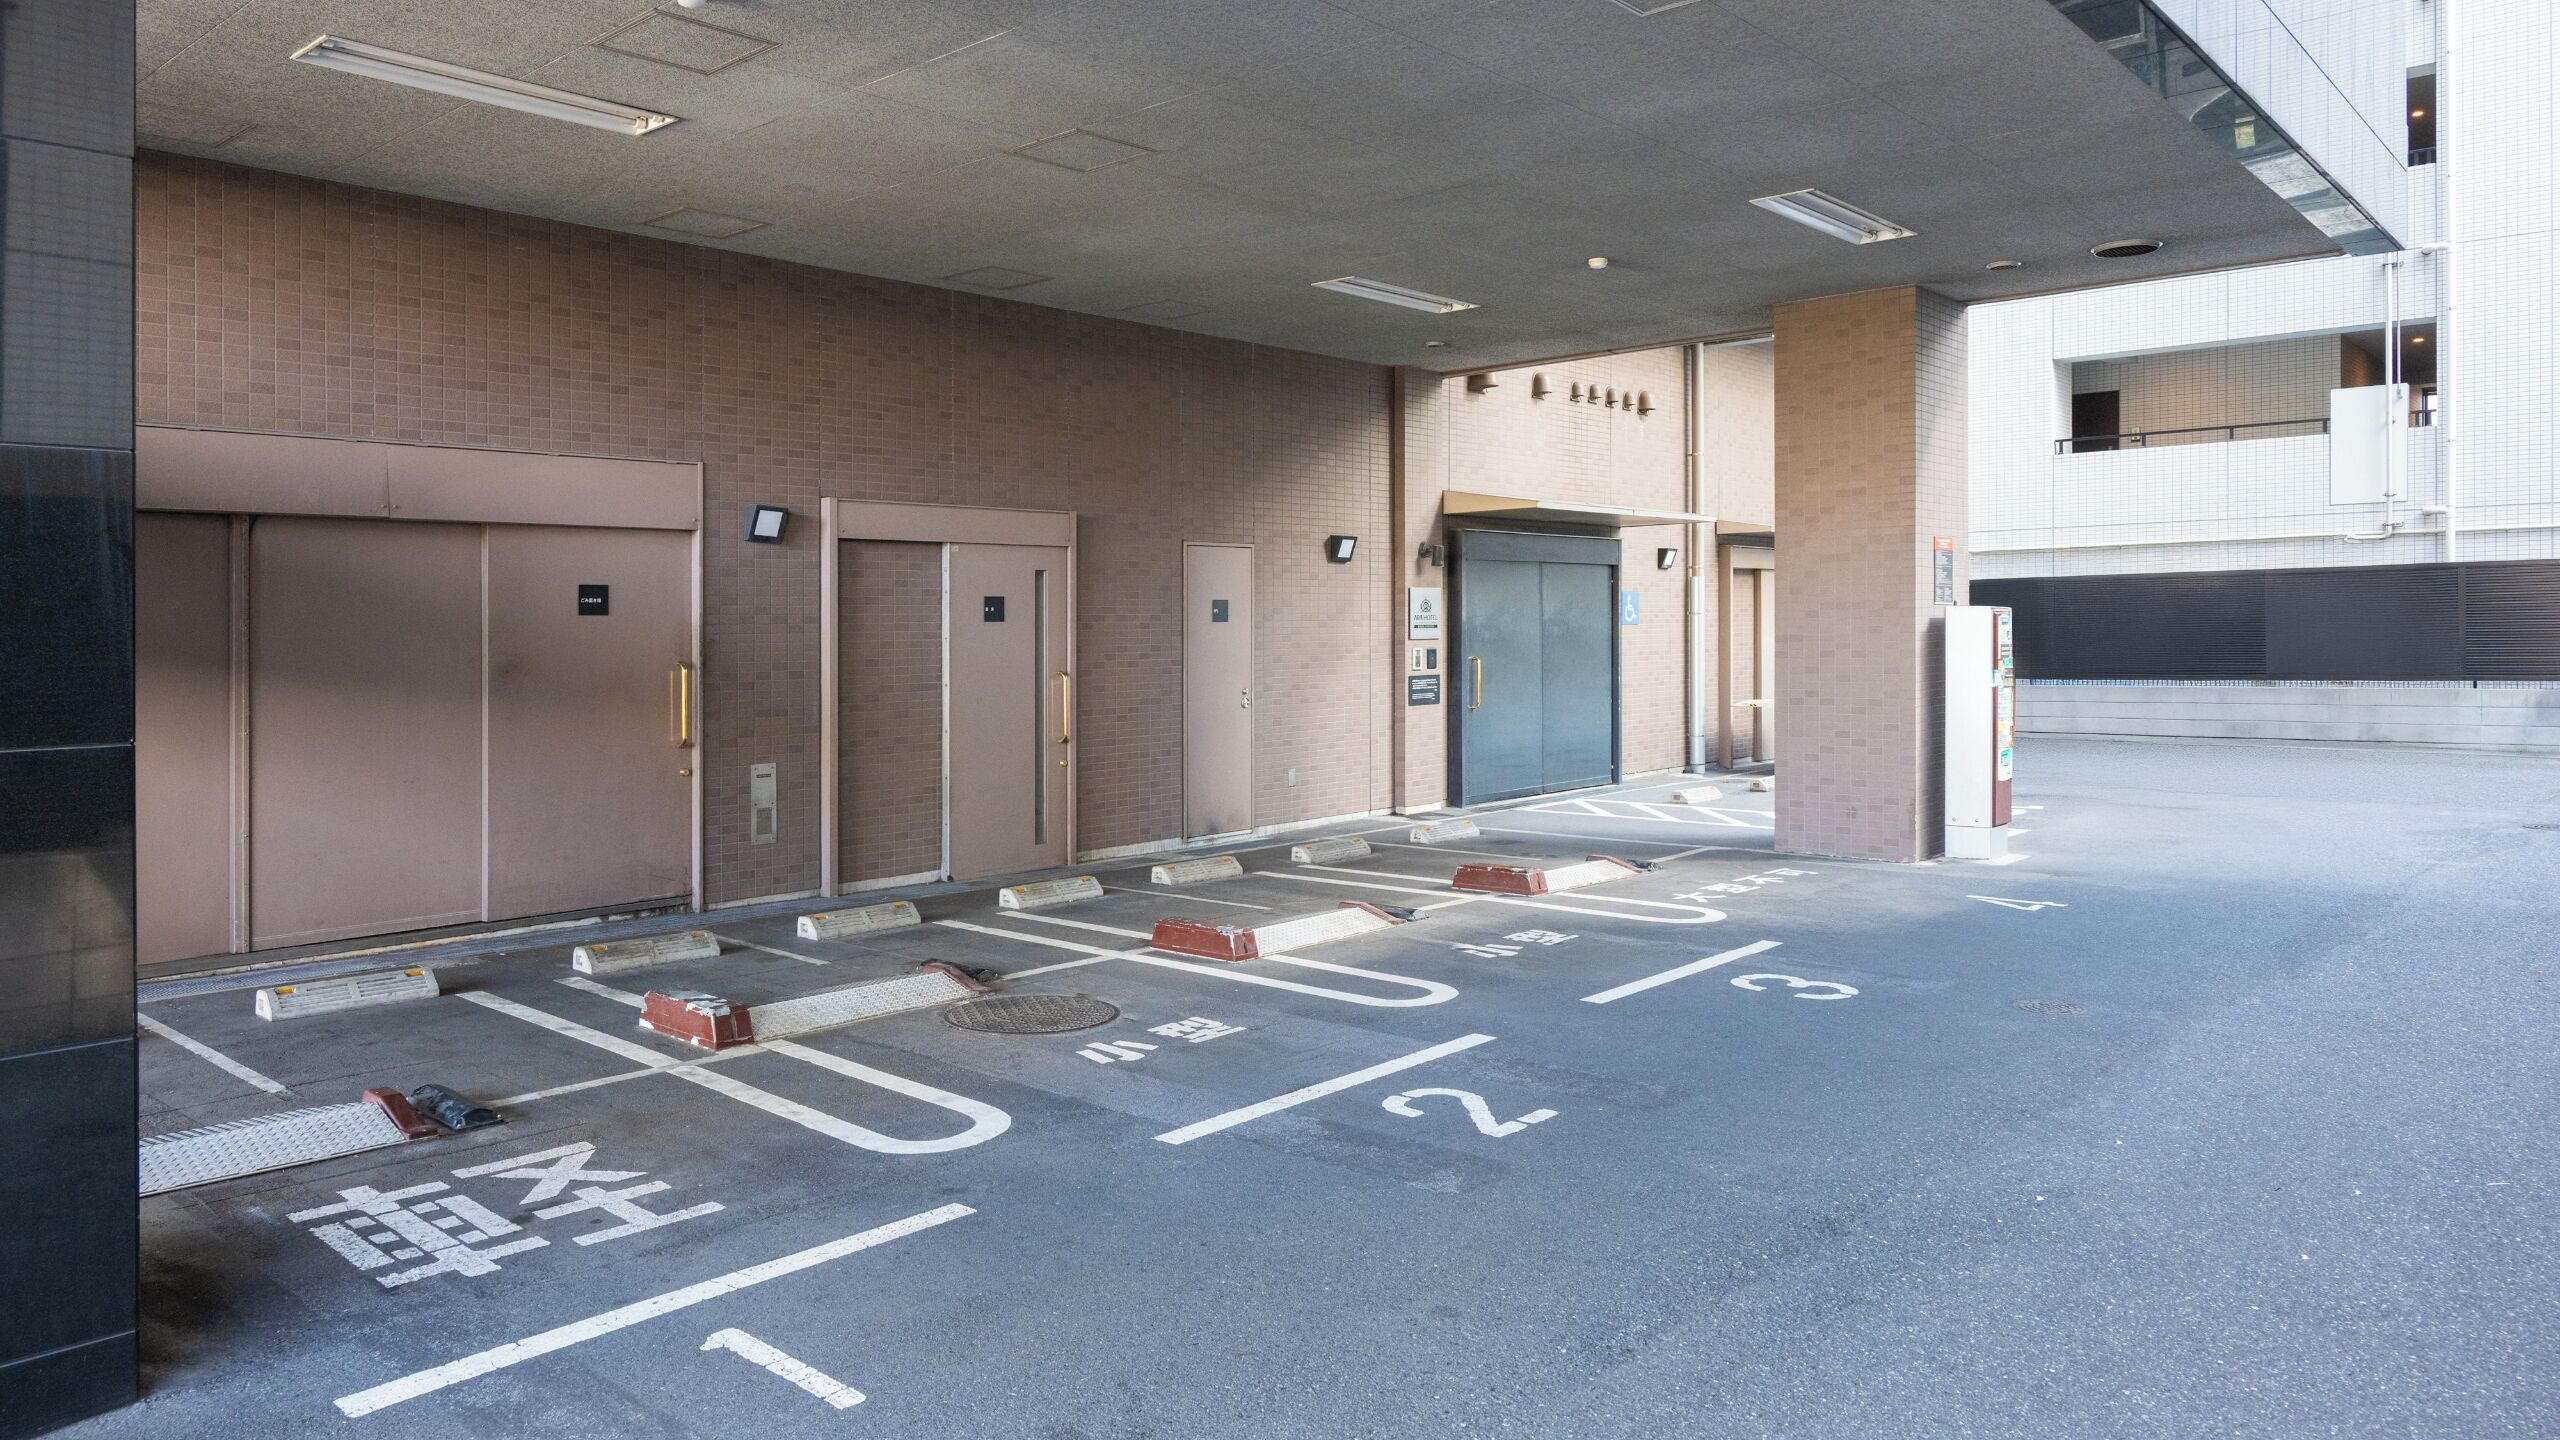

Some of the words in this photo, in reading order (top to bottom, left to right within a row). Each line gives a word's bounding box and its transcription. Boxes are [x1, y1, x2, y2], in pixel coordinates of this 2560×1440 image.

[1672, 868, 1819, 903] 大型不可
[1966, 894, 2068, 912] 4
[1452, 929, 1580, 958] 小型
[1730, 973, 1860, 1001] 3
[1075, 1016, 1248, 1065] 小型
[1382, 1087, 1559, 1139] 2
[286, 1141, 726, 1288] 軽
[700, 1328, 866, 1411] 1
